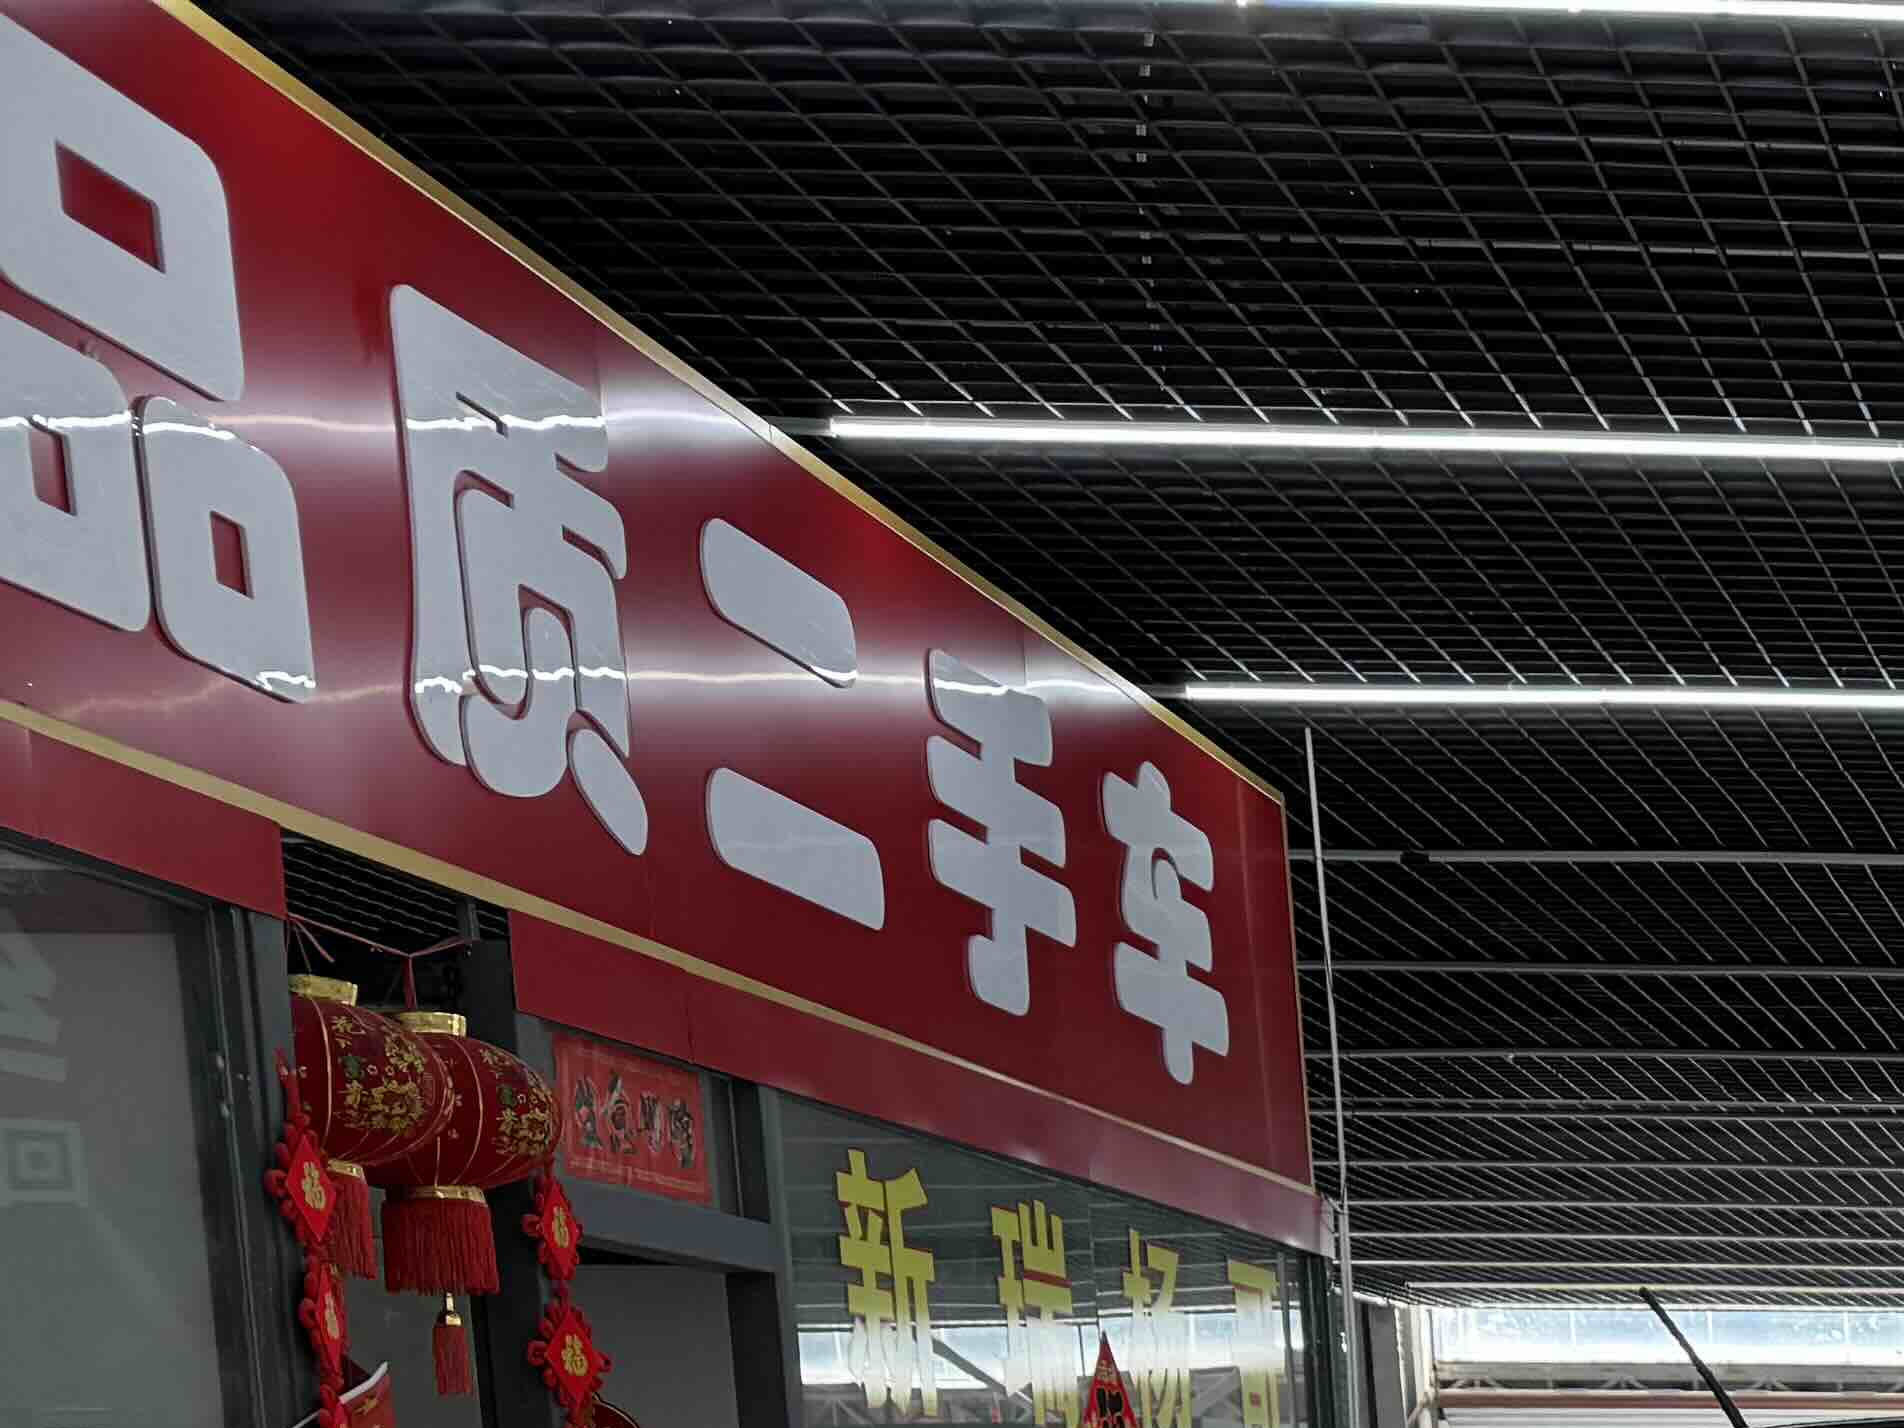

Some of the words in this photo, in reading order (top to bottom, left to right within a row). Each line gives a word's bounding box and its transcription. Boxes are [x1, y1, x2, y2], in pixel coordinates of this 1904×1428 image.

[0, 20, 1231, 1087] 品质二手车
